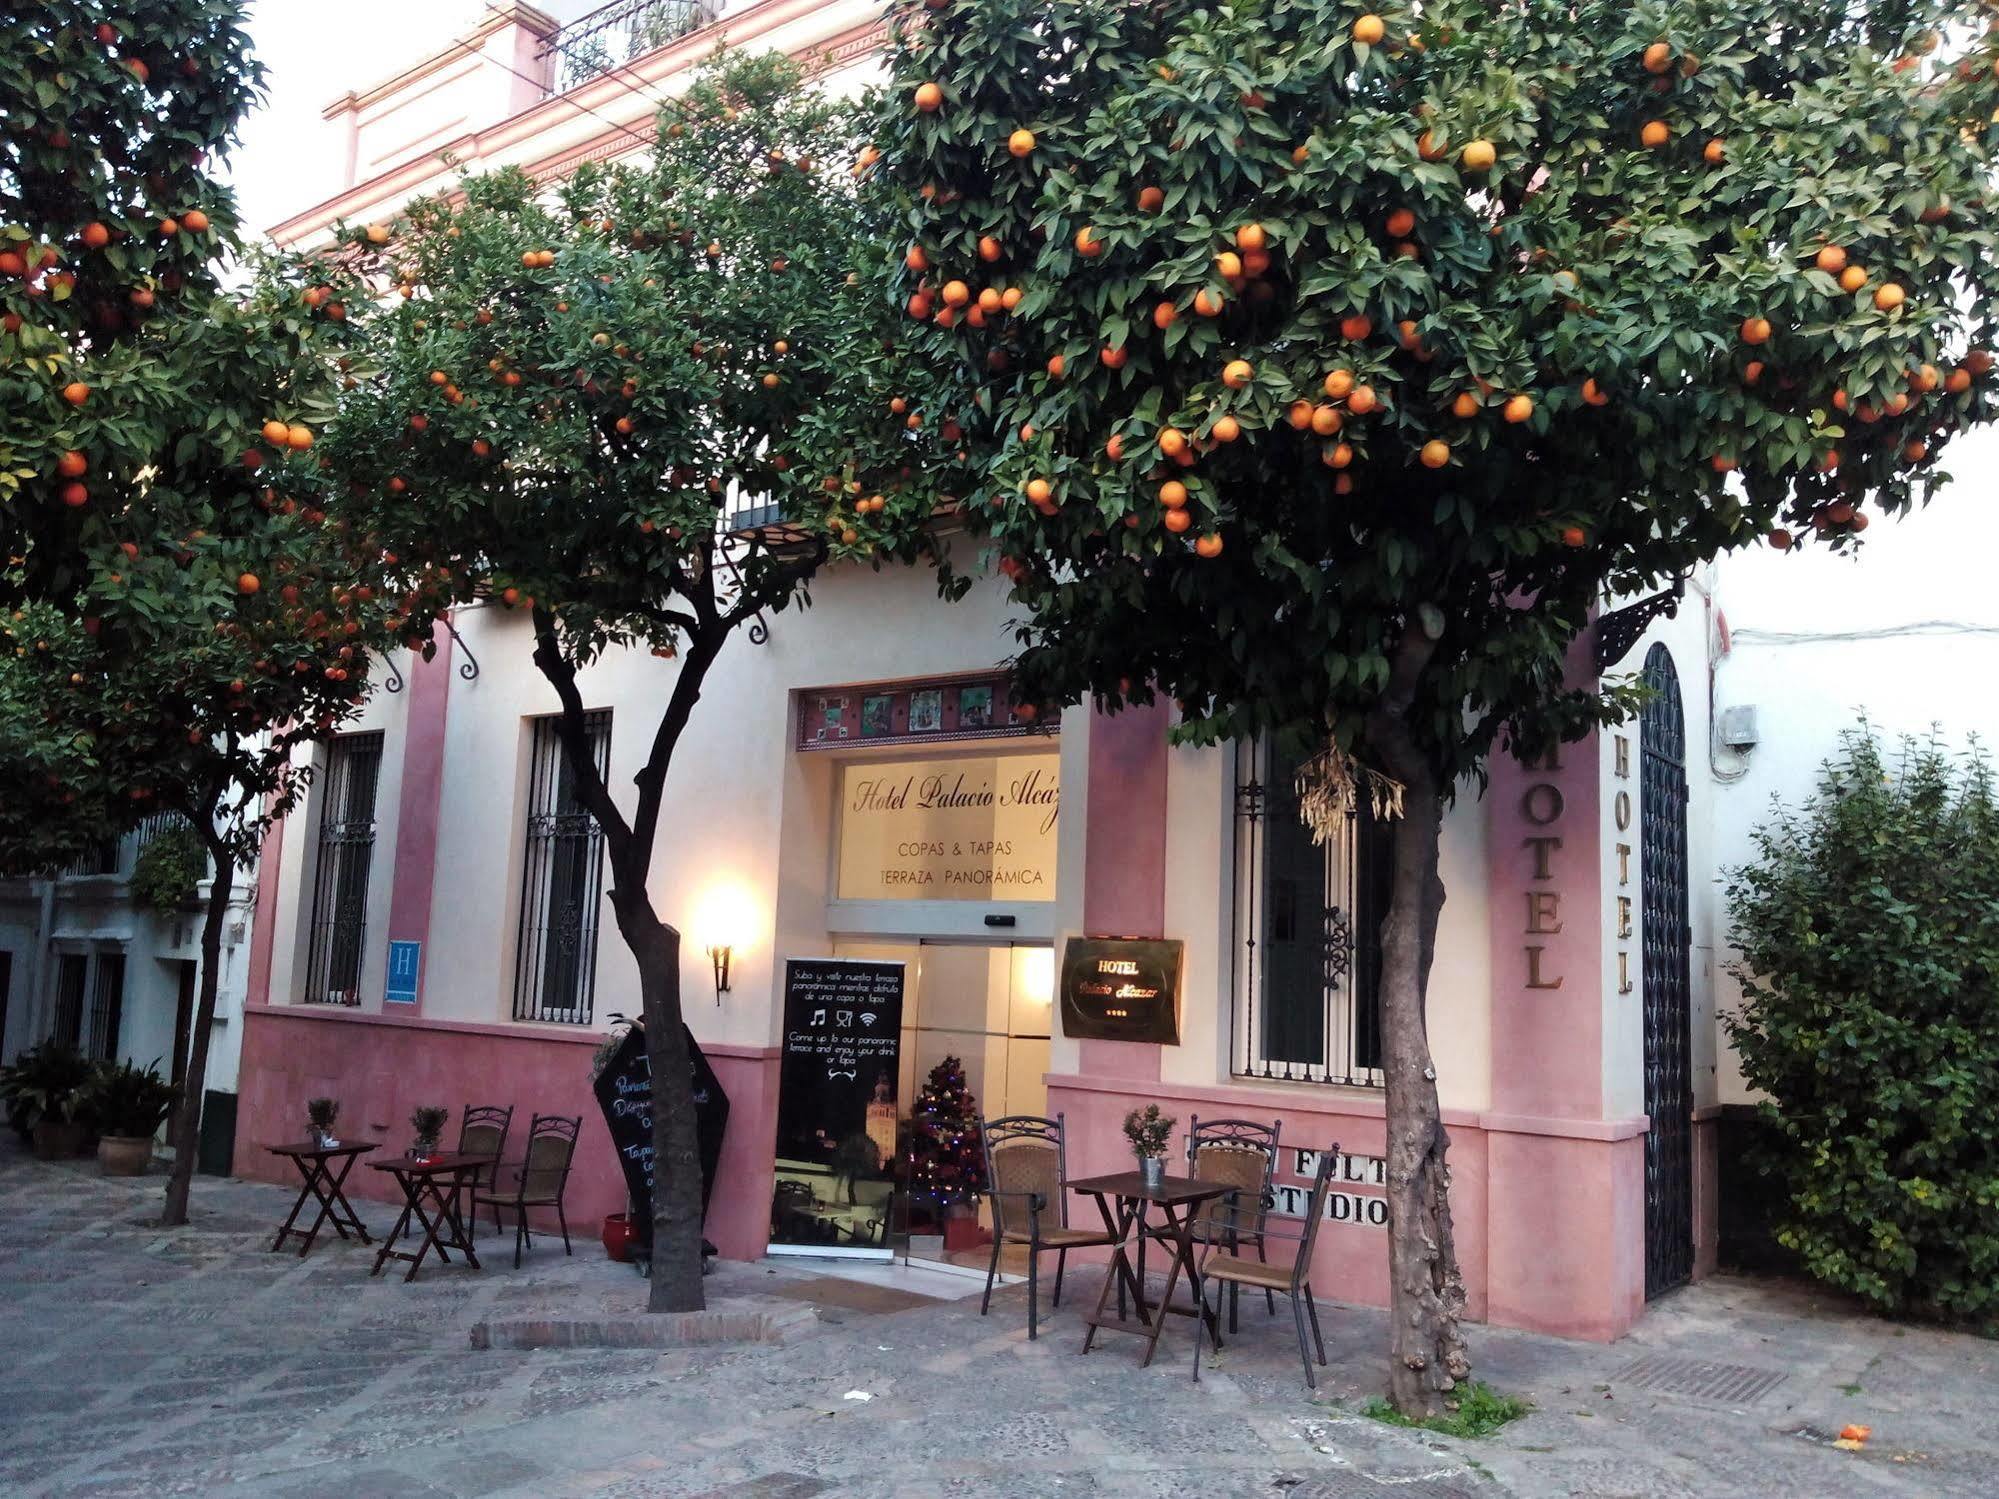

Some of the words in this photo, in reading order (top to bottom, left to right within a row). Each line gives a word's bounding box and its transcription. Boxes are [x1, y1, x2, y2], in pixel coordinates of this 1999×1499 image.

[852, 776, 914, 812] Hotel
[917, 773, 994, 808] Palacio
[898, 842, 945, 857] COPAS
[952, 842, 962, 856] &
[970, 840, 1012, 855] TAPAS
[1614, 734, 1633, 995] HOTEL
[880, 870, 933, 884] TERRAZA
[945, 866, 1043, 884] PANORÁMICA
[396, 947, 412, 975] H
[1098, 960, 1139, 975] HOTEL
[804, 992, 815, 1001] de
[836, 994, 856, 1004] copa
[789, 1031, 814, 1042] Come
[817, 1035, 827, 1044] up
[831, 1034, 838, 1043] to
[789, 1042, 813, 1052] terrace
[816, 1044, 833, 1053] and
[835, 1047, 855, 1058] enjoy
[858, 1048, 874, 1057] your
[1260, 1186, 1388, 1225] STDIO
